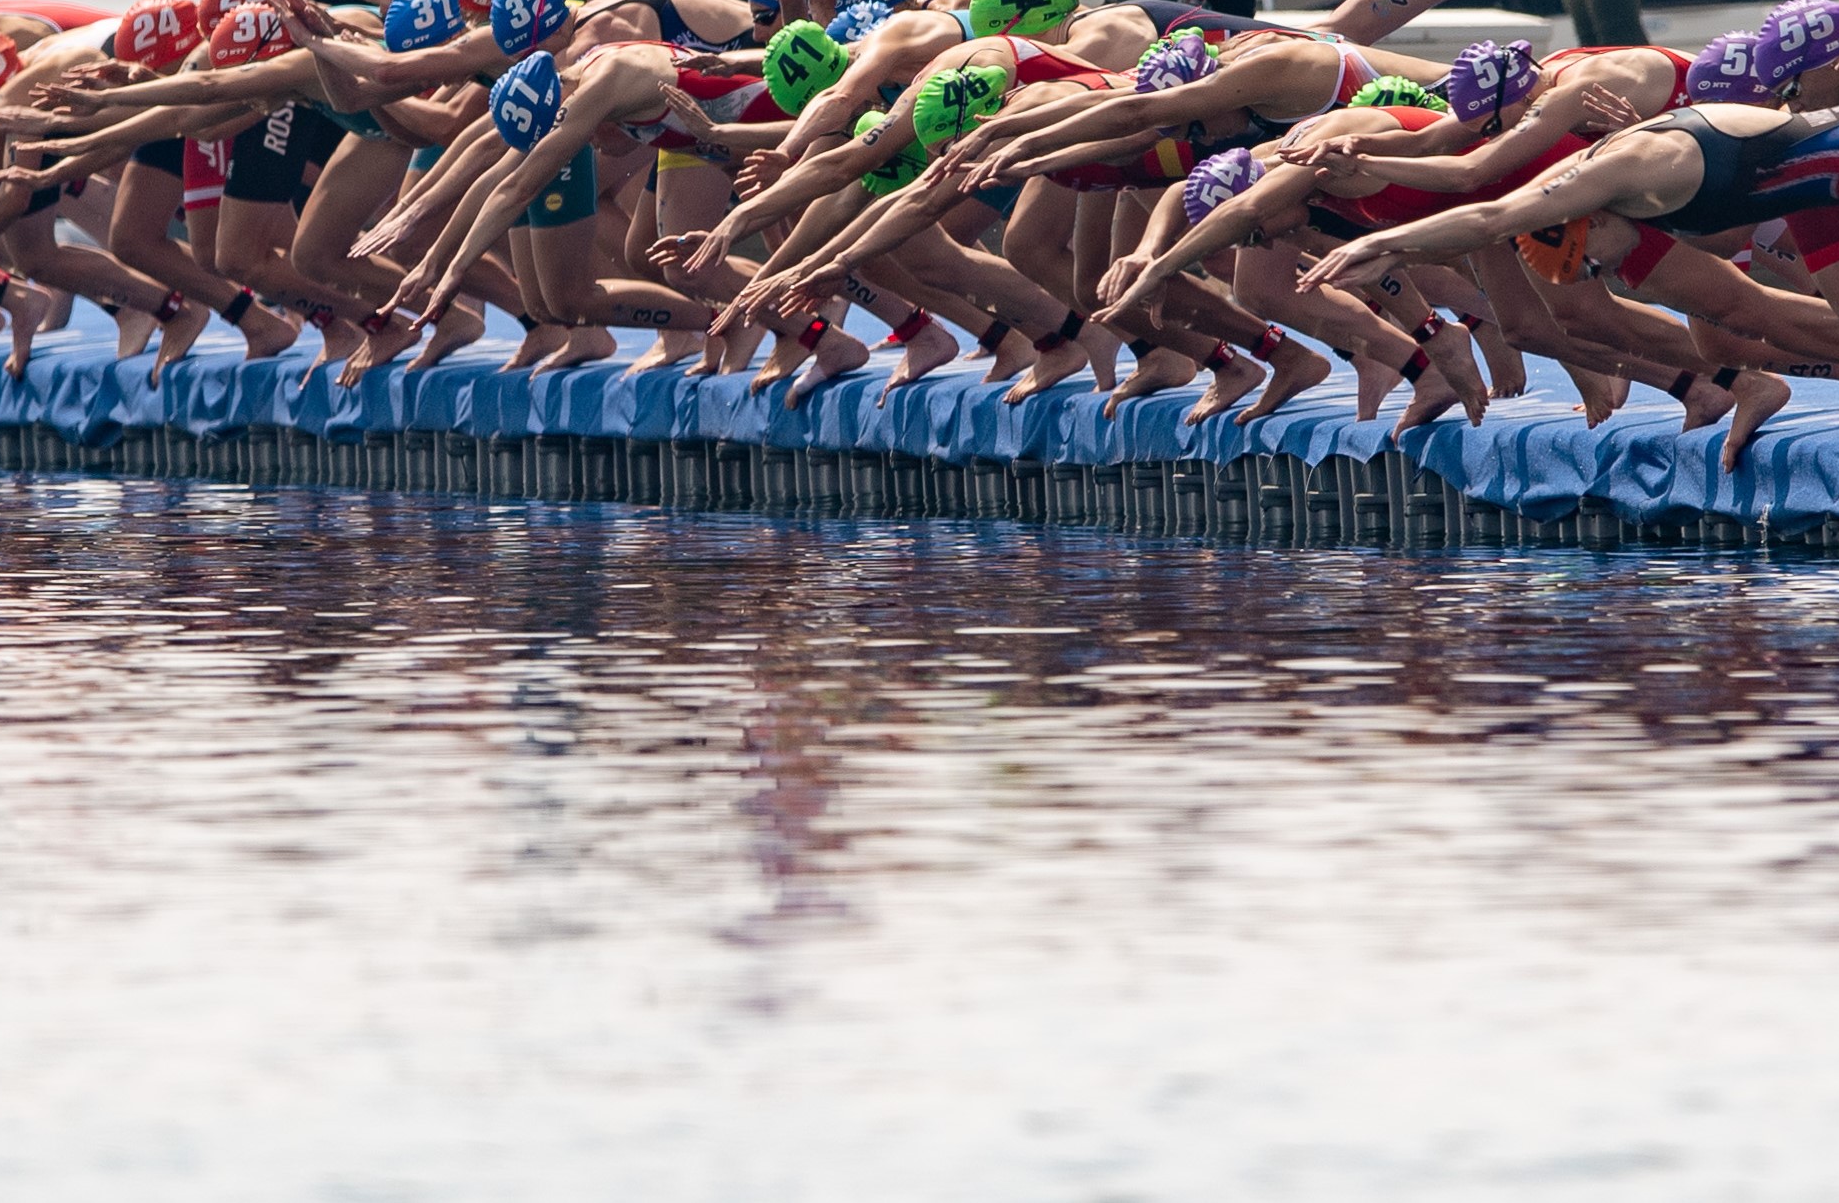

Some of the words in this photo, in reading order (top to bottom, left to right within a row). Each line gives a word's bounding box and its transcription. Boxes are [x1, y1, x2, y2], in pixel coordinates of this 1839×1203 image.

[132, 7, 181, 53] 24
[232, 10, 283, 44] 30
[1777, 7, 1835, 53] 55
[777, 33, 826, 88] 41
[1472, 50, 1520, 90] 53
[1720, 43, 1759, 77] 5
[1784, 55, 1804, 70] NTT
[942, 71, 991, 109] 46
[1712, 81, 1732, 89] NTT
[500, 78, 540, 134] 37
[1199, 162, 1244, 209] 54
[632, 308, 672, 325] 30
[1788, 362, 1834, 380] 43
